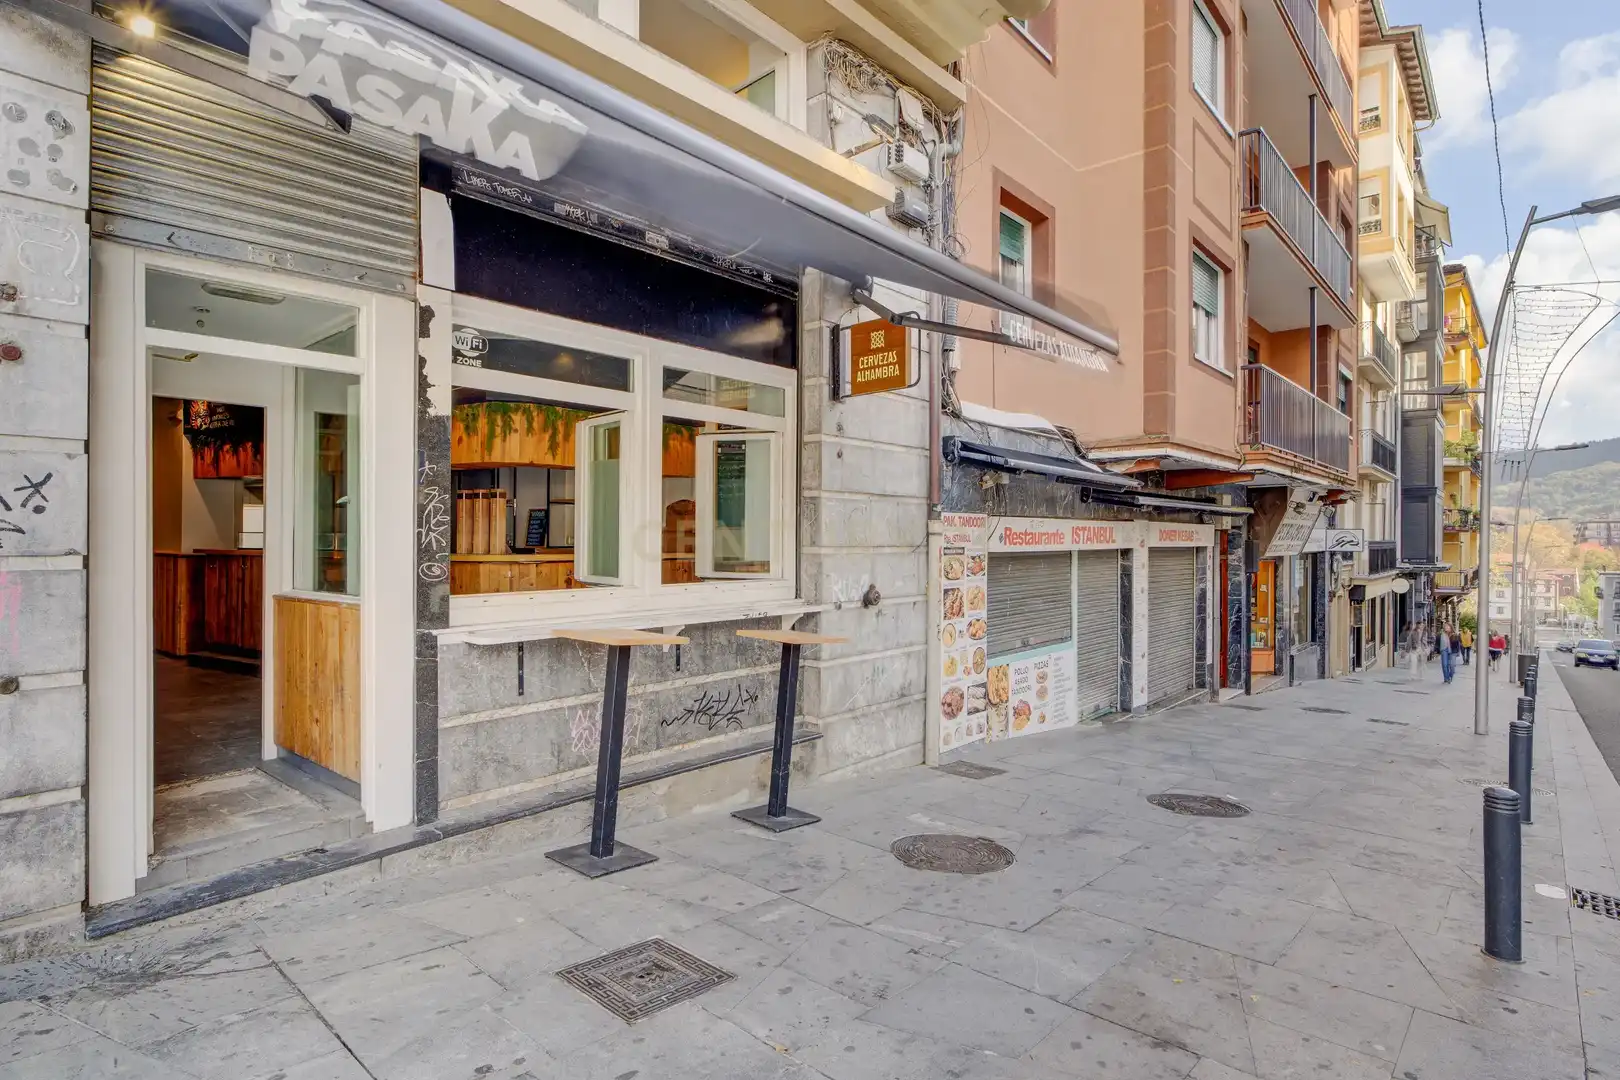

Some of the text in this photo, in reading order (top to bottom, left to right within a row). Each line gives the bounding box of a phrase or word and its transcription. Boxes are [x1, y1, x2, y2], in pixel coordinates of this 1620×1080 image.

[248, 26, 541, 182] PASAKA
[456, 356, 483, 368] ZONE
[859, 350, 897, 369] CERVEZAS
[856, 363, 900, 383] ALHAMBRA
[1004, 526, 1116, 546] Restaurante ISTANBUL
